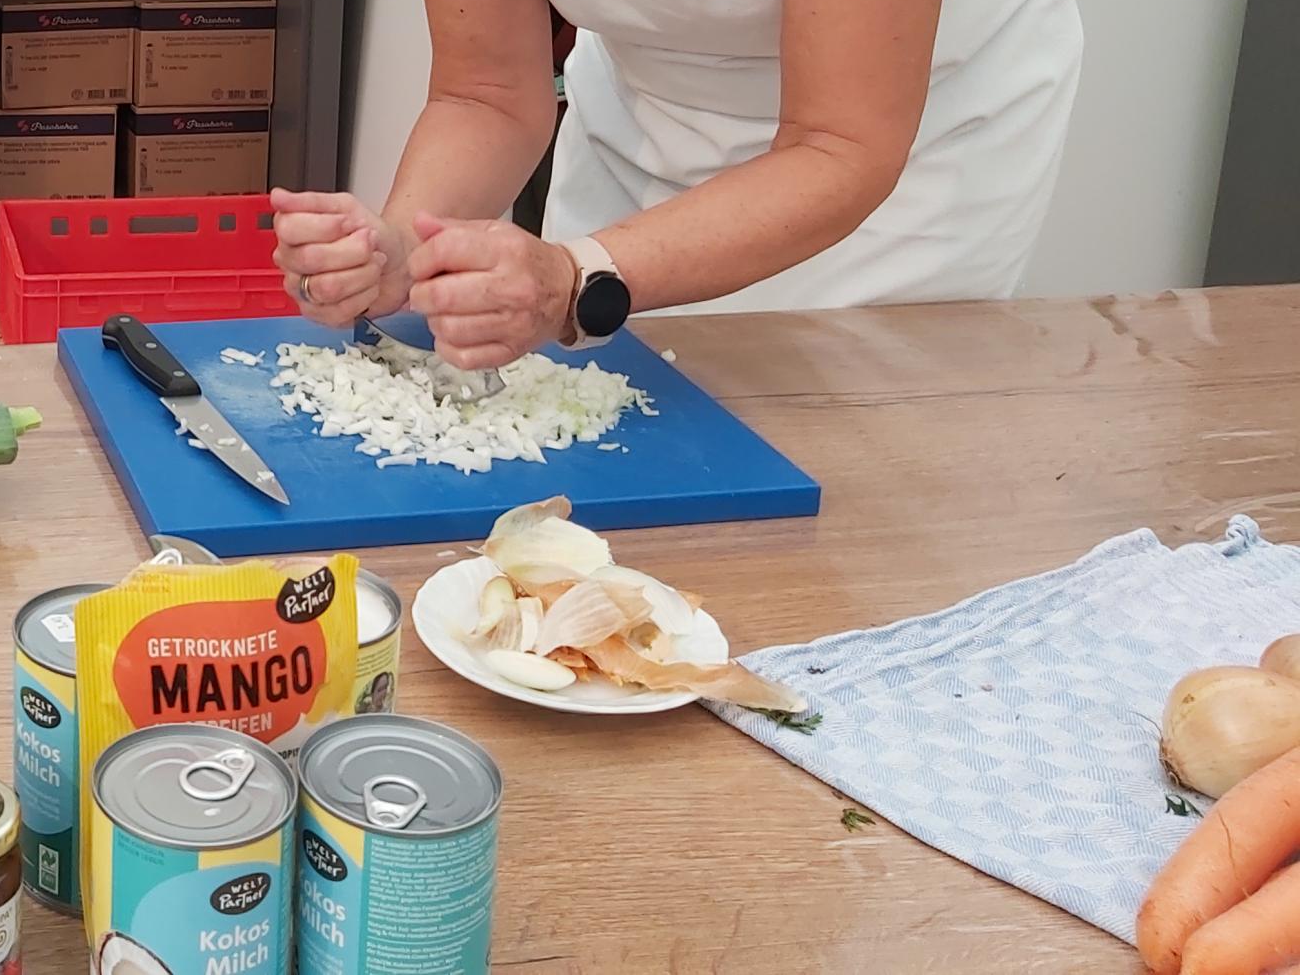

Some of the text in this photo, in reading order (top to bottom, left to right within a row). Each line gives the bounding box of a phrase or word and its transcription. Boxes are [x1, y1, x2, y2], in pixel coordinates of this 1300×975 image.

[293, 569, 329, 594] WELT
[147, 629, 279, 659] GETROCKNETE
[150, 645, 313, 715] MANGO
[28, 692, 54, 714] WELT
[16, 719, 62, 762] Kokos
[17, 746, 61, 787] Milch
[312, 838, 339, 864] WELT
[231, 876, 264, 894] WELT
[200, 918, 271, 952] Kokos
[205, 942, 269, 975] Milch
